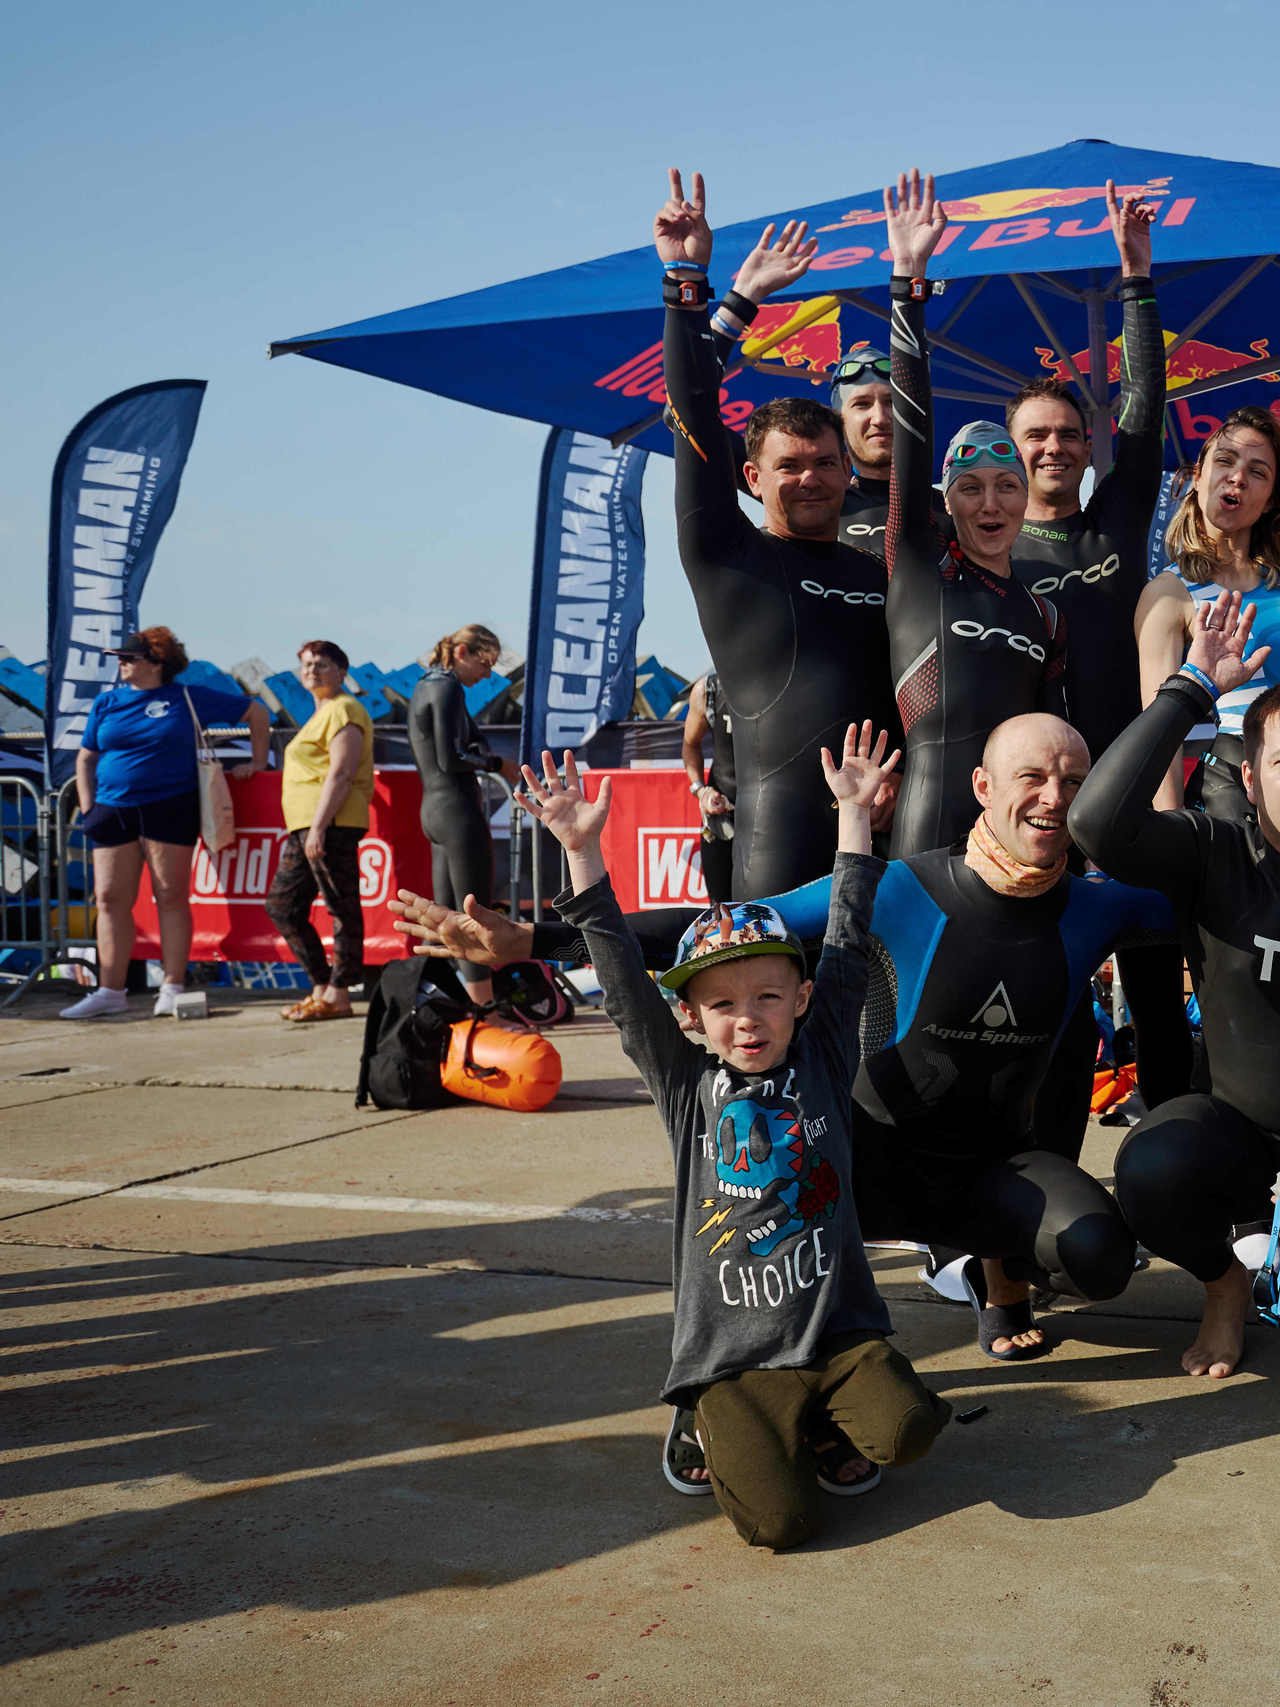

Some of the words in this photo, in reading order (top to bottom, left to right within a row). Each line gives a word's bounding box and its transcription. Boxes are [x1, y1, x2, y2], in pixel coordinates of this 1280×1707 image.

[967, 197, 1198, 251] Bul
[131, 457, 161, 548] SWIMMING
[1031, 553, 1120, 595] orca
[1148, 529, 1163, 581] ATER
[546, 432, 625, 748] OCEANMAN
[608, 612, 622, 664] OPEN
[615, 539, 628, 599] WATER
[801, 580, 885, 606] orca
[951, 620, 1046, 664] orca
[921, 1023, 977, 1040] Aqua
[718, 1227, 830, 1308] CHOICE
